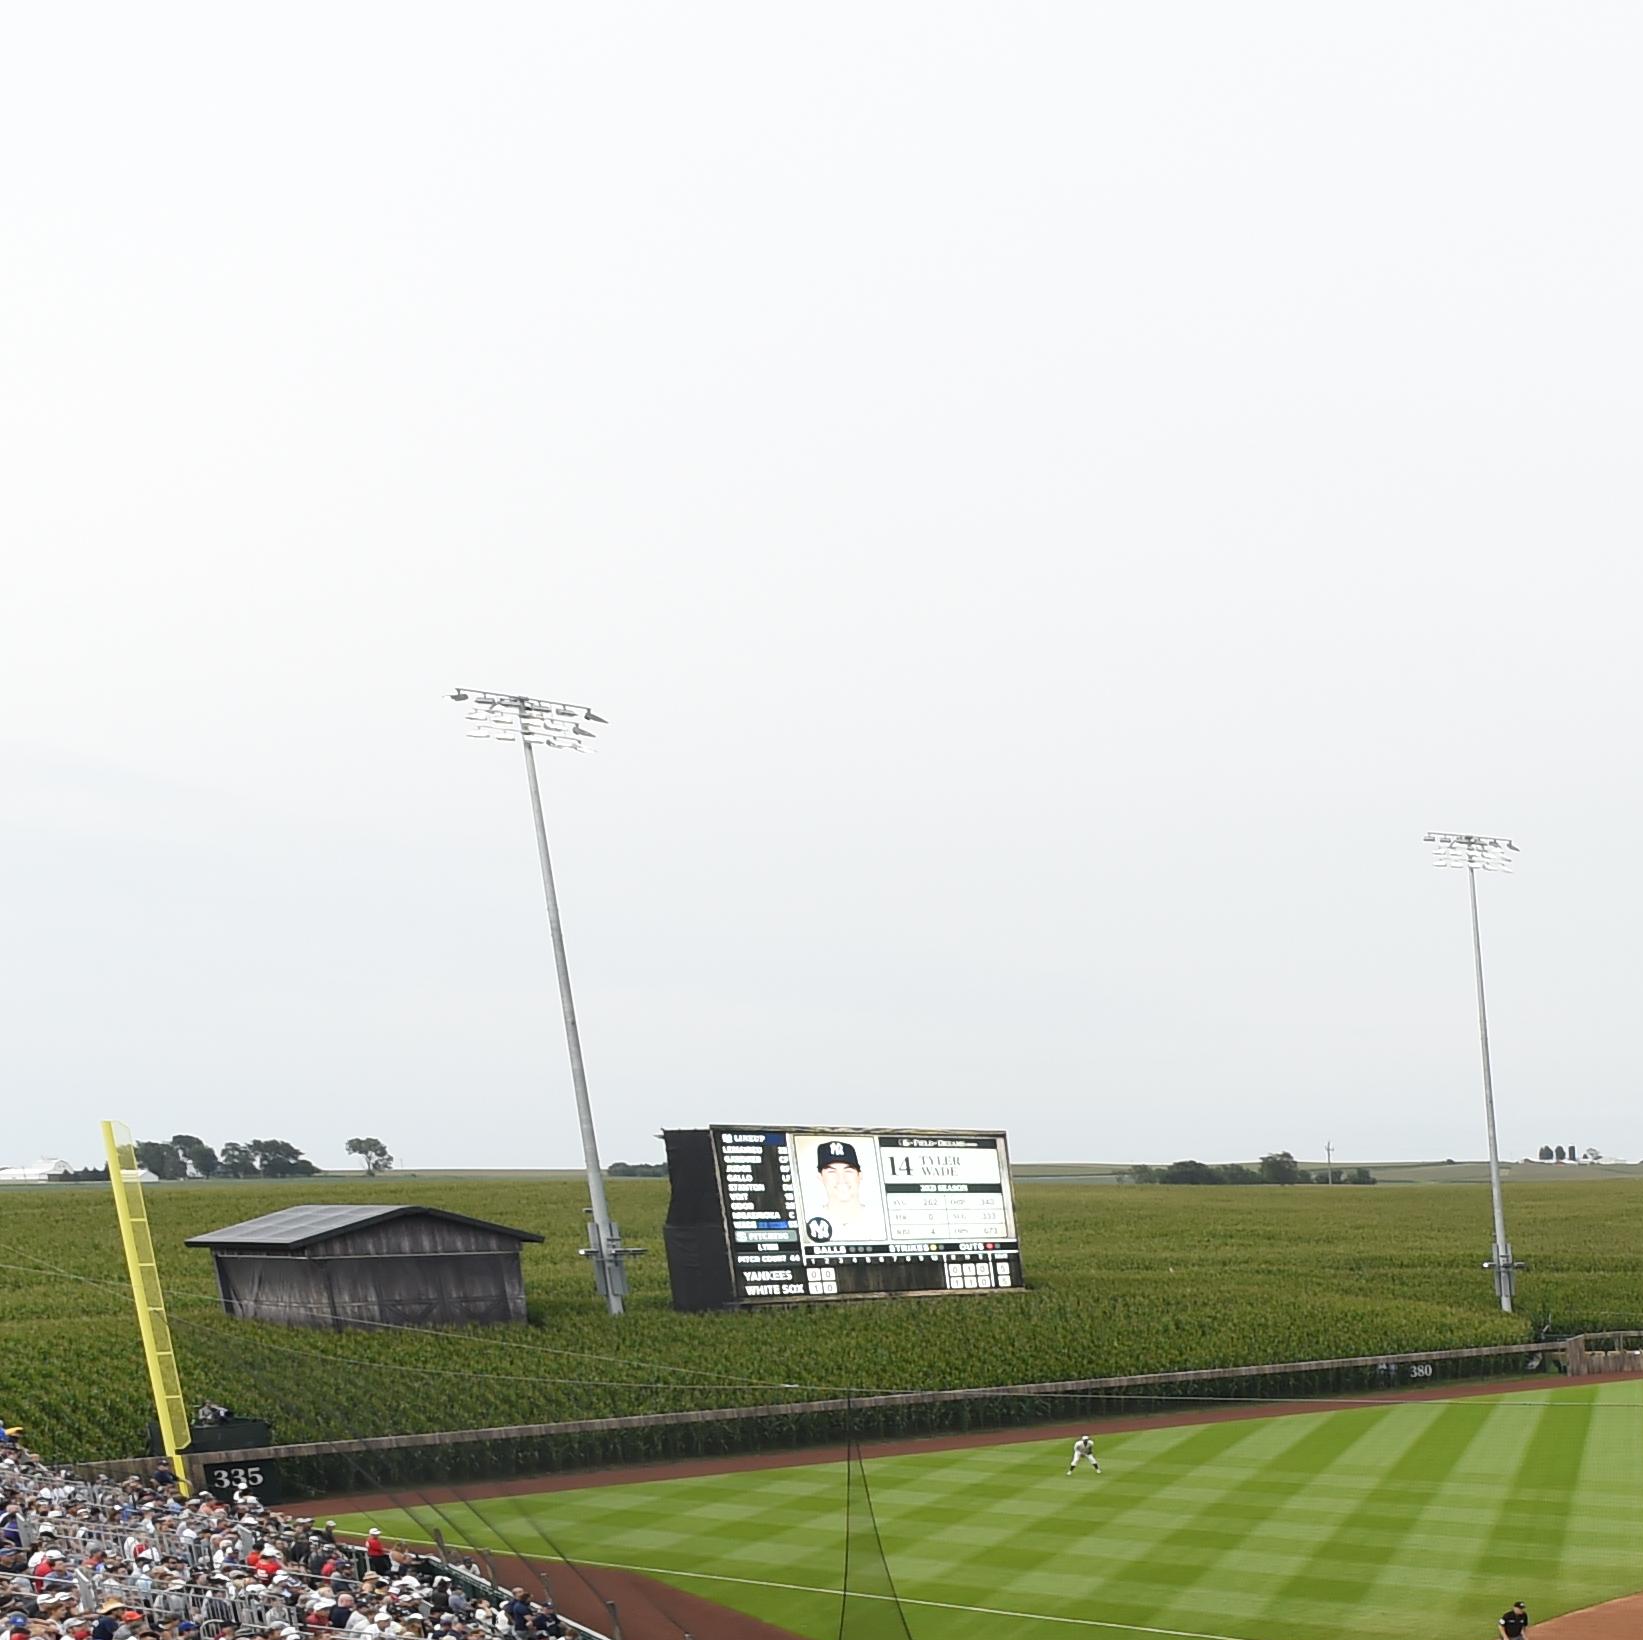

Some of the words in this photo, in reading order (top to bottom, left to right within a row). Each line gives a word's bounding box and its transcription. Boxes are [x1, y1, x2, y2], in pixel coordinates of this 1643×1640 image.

[888, 1156, 914, 1176] 14
[919, 1156, 961, 1166] TYLER
[921, 1166, 959, 1177] WADE
[889, 1243, 929, 1252] STRIKES
[959, 1242, 984, 1251] OUTS
[742, 1270, 793, 1282] YANKEES
[744, 1284, 780, 1296] WHITE
[782, 1283, 804, 1295] SOX
[1410, 1364, 1432, 1378] 380
[213, 1466, 264, 1489] 335
